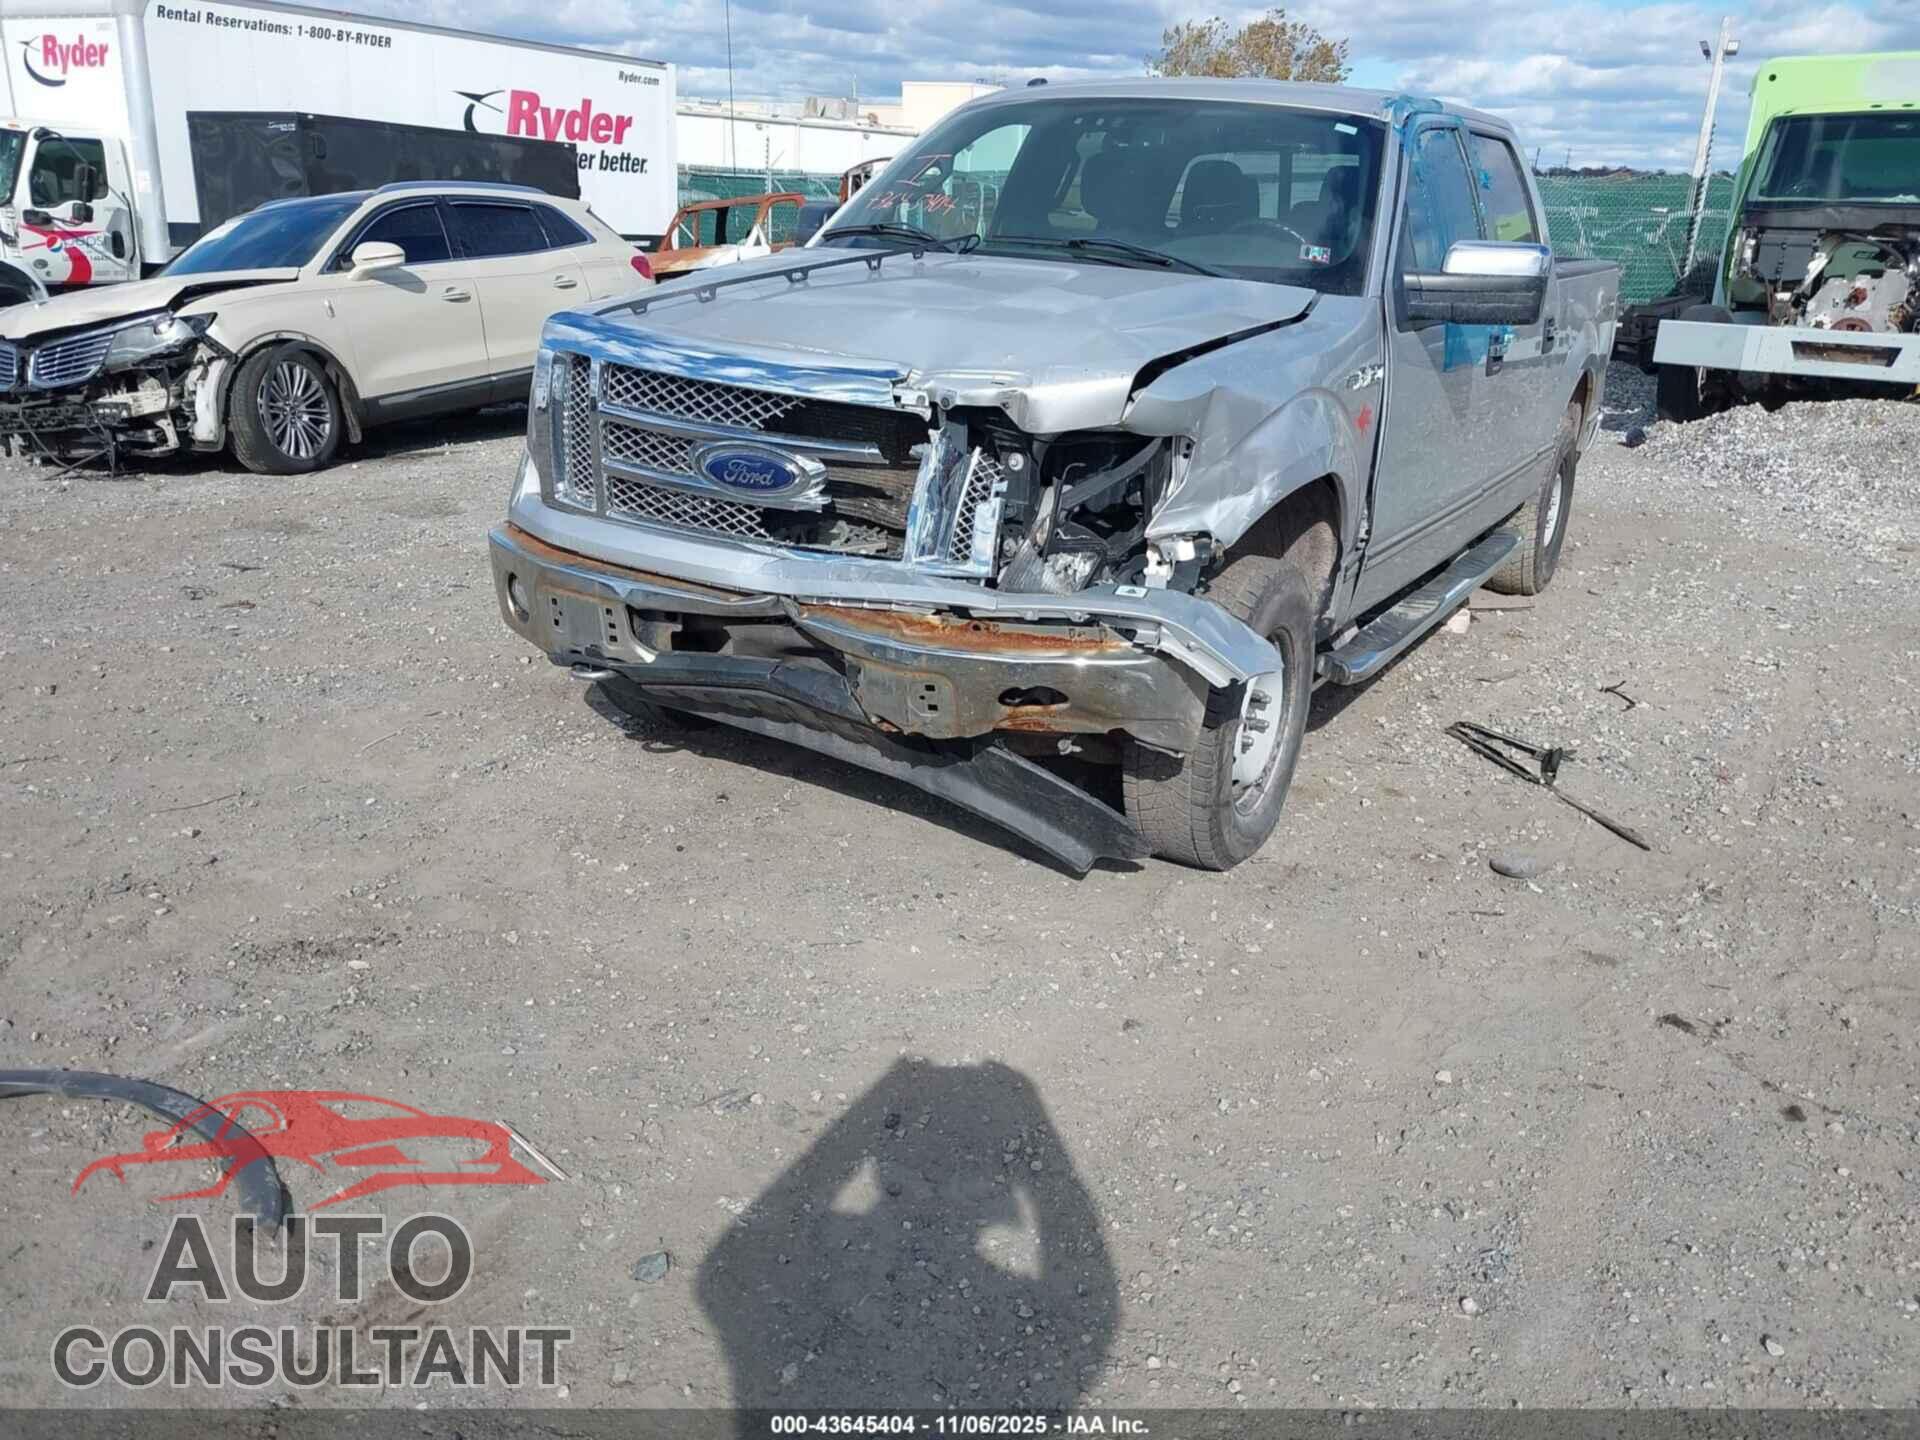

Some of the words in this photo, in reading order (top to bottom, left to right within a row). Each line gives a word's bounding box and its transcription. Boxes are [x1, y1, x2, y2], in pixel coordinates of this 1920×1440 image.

[157, 5, 201, 24] Rental
[206, 12, 293, 36] Reservations:
[298, 25, 392, 49] 1-800-BY-RYDER
[42, 34, 109, 75] Ryder
[618, 71, 660, 86] Ryder.com
[507, 89, 633, 145] Ryder
[599, 150, 648, 174] better.
[723, 460, 775, 486] Ford
